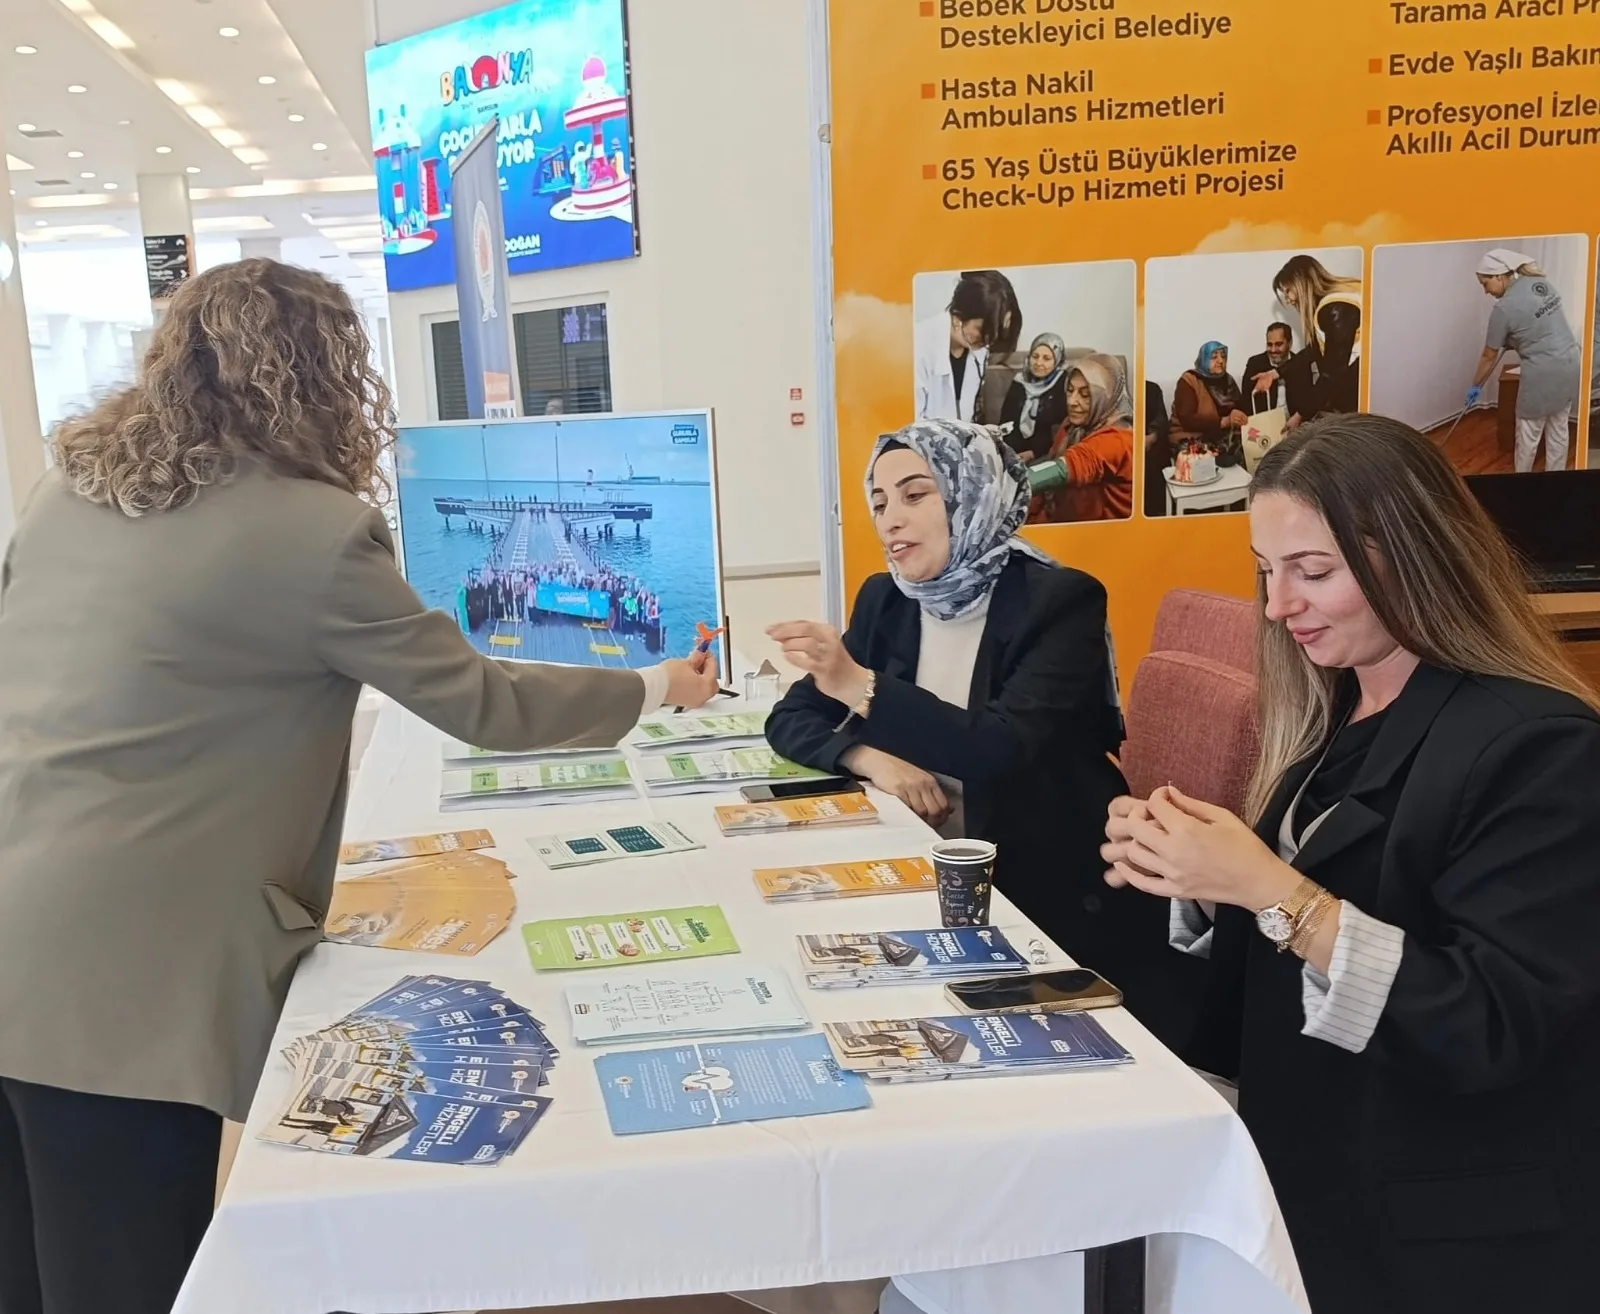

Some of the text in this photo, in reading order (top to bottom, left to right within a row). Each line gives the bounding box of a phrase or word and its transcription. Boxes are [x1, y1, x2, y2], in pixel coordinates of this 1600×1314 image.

[941, 0, 1026, 19] Bebek
[1390, 2, 1486, 24] Tarama
[941, 13, 1231, 48] Destekleyici Belediye
[1390, 51, 1454, 75] Evde
[1464, 47, 1521, 74] Yaşlı
[942, 70, 1094, 101] Hasta Nakil
[942, 92, 1225, 130] Ambulans Hizmetleri
[1388, 91, 1600, 126] Profesyonel İzle
[1386, 131, 1452, 156] Akıllı
[1461, 127, 1510, 151] Acil
[943, 140, 1298, 182] 65 Yaş Üstü Büyüklerimize
[943, 168, 1285, 210] Check-Up Hizmeti Projesi
[986, 1016, 1022, 1048] ENGELLİ
[411, 1102, 460, 1155] HİZMETLERİ
[436, 1105, 475, 1145] ENGELLİ
